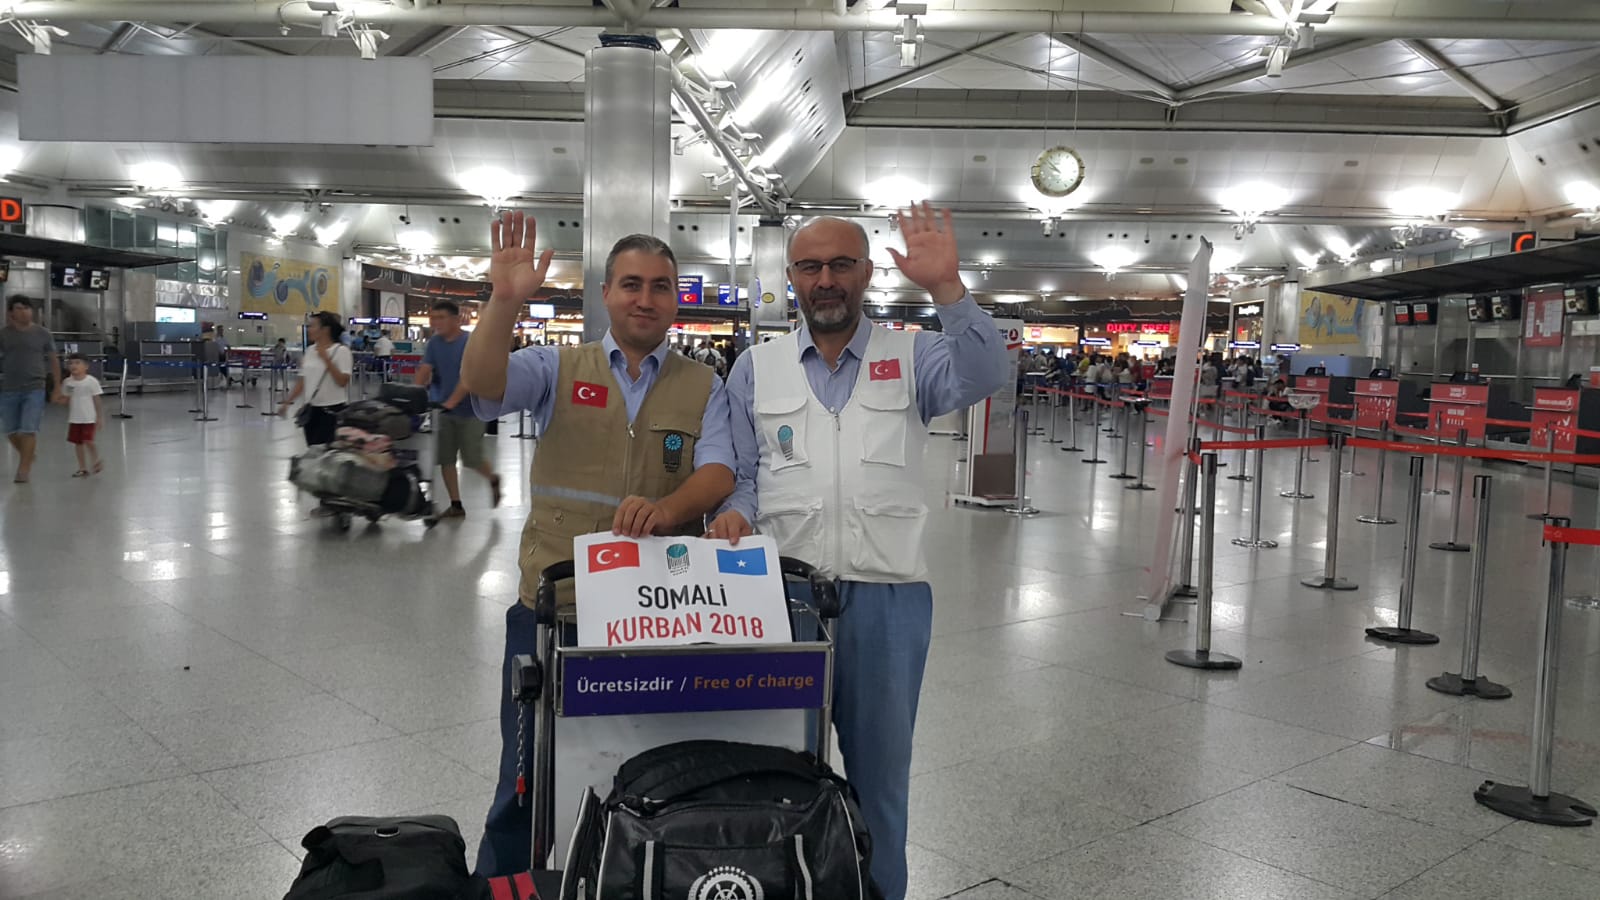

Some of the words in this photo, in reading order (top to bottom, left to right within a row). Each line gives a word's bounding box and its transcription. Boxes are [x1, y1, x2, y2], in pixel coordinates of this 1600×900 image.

[1, 198, 21, 221] D
[1106, 323, 1137, 333] DUTY
[1141, 323, 1170, 334] FREE
[607, 612, 702, 647] KURBAN
[709, 612, 764, 639] 2018
[577, 676, 674, 693] Ücretsizdir
[694, 676, 730, 689] Free
[735, 673, 753, 688] of
[758, 673, 814, 689] charge
